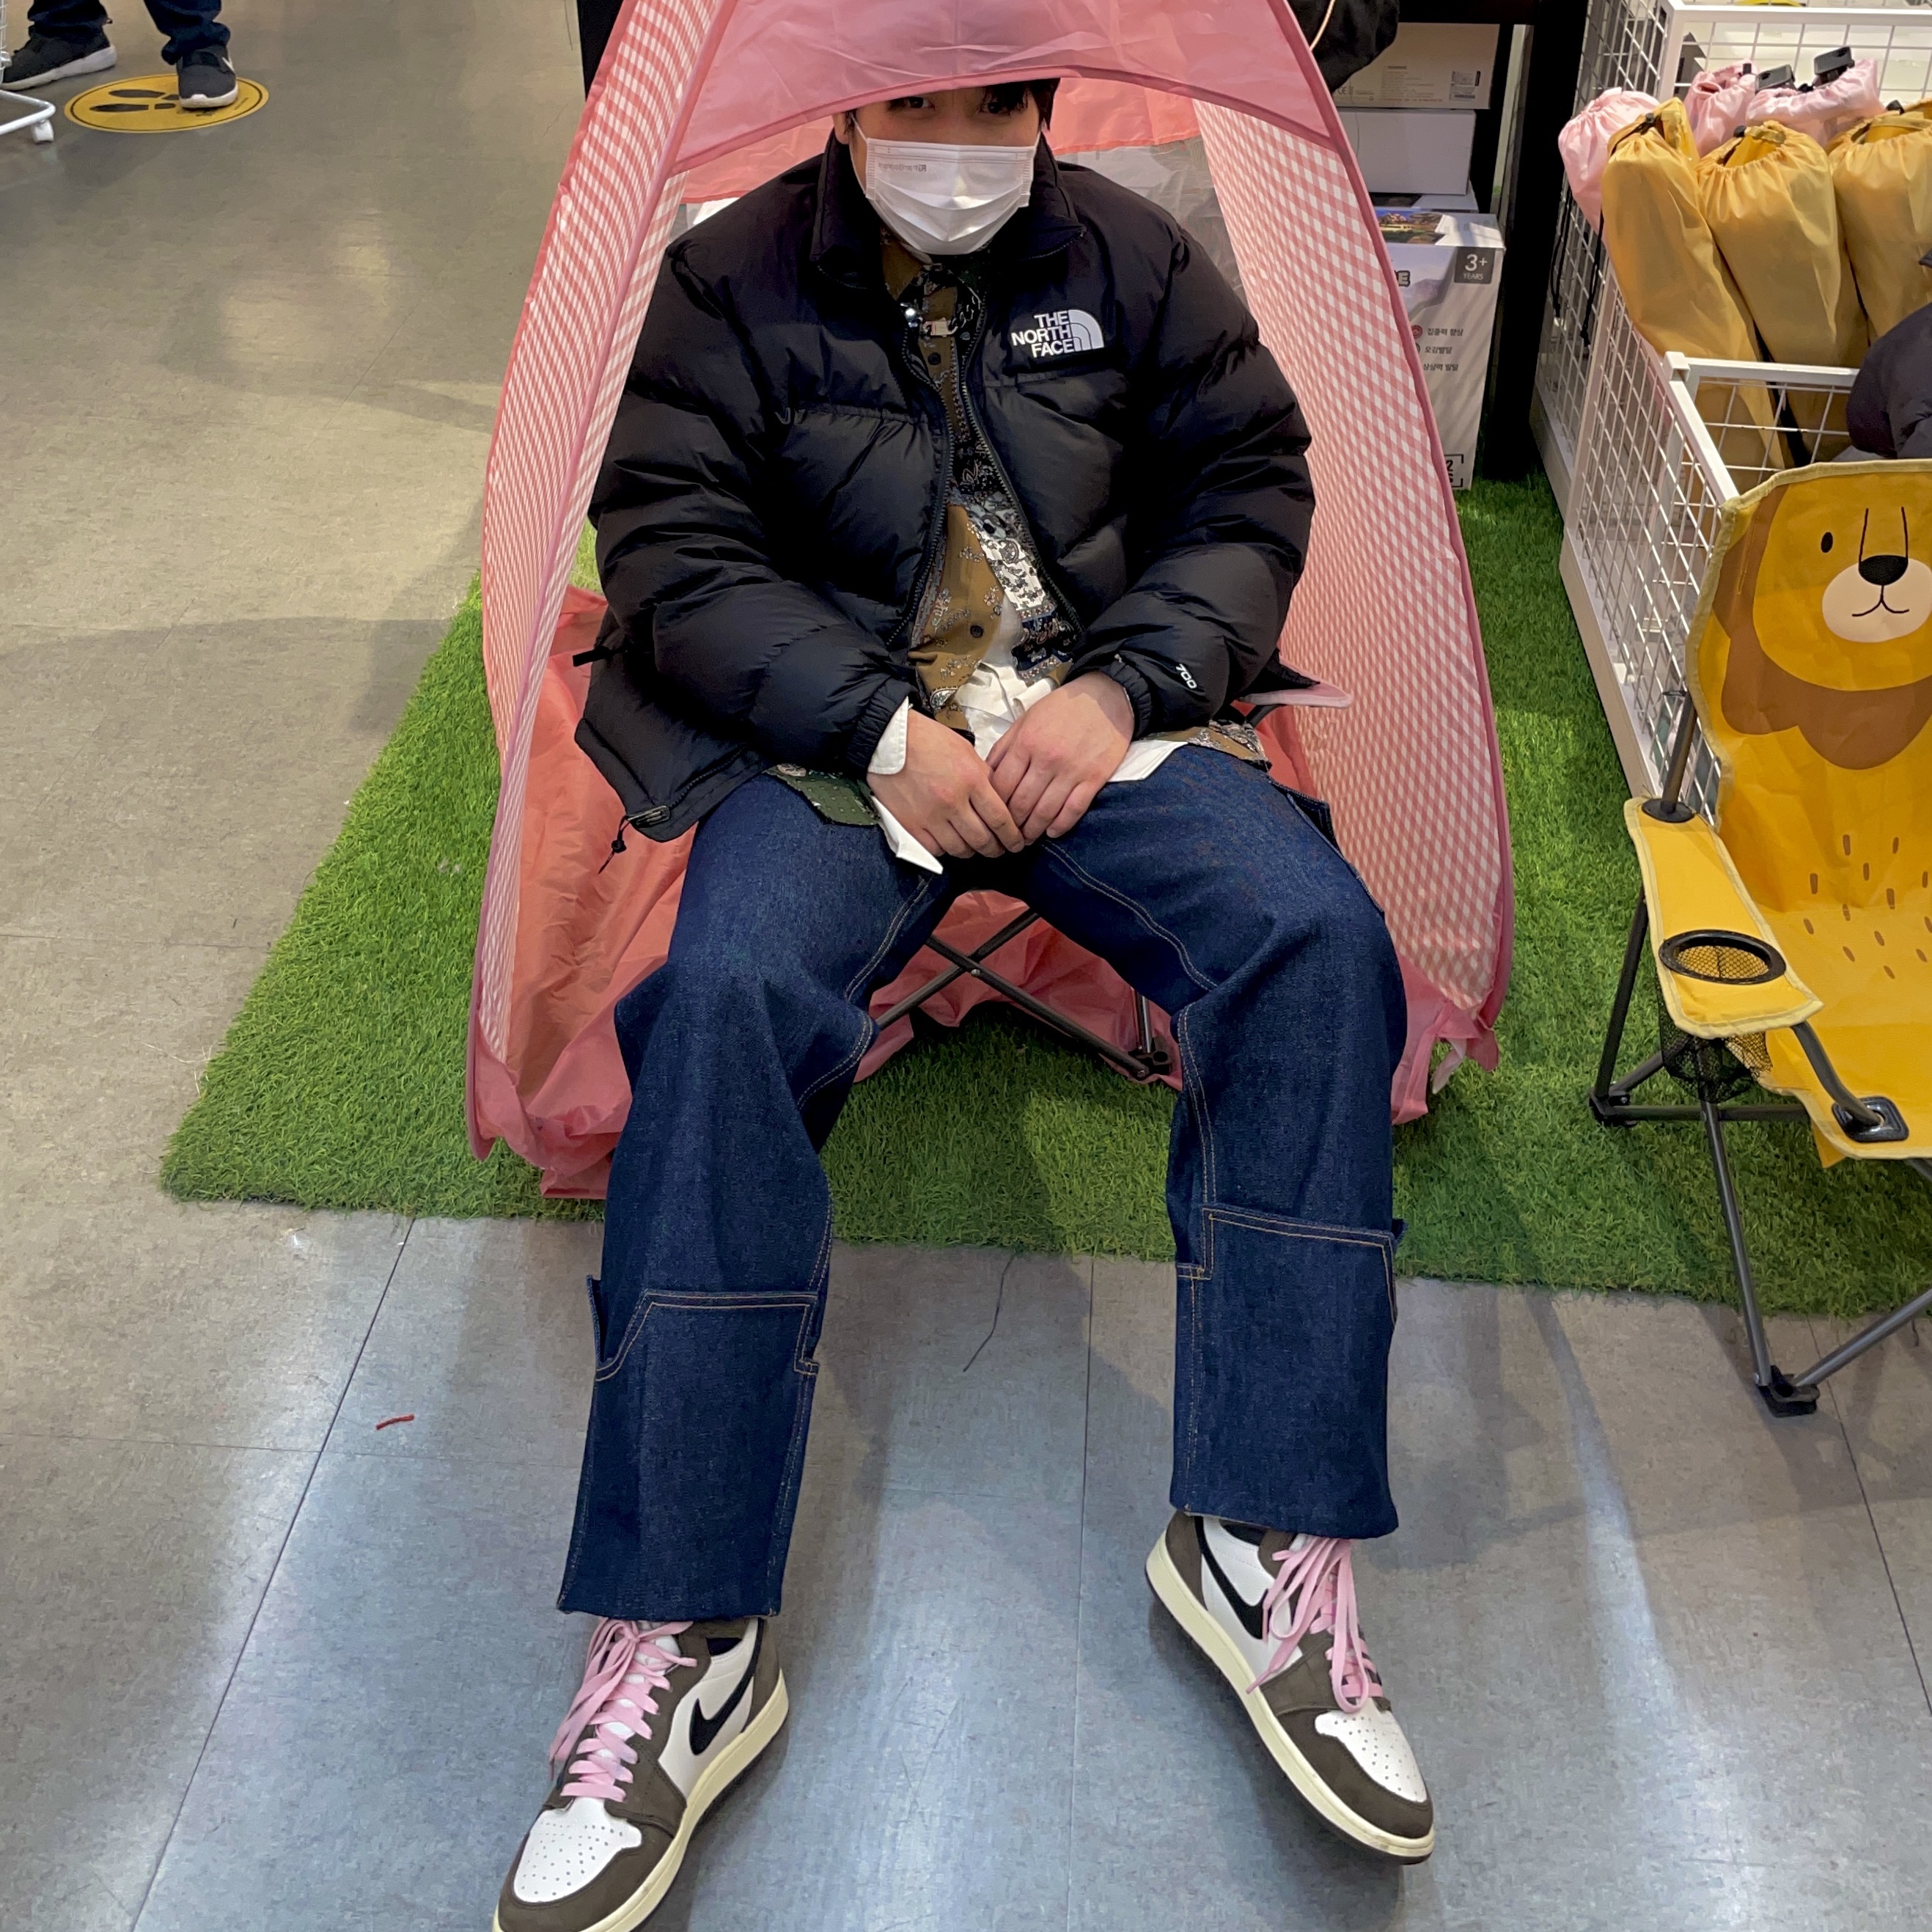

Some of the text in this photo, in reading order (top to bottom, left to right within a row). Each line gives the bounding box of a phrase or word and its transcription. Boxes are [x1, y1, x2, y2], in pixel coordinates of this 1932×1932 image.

[1465, 254, 1488, 271] 3+
[1033, 310, 1070, 328] THE
[1011, 324, 1071, 346] NORTH
[1031, 338, 1075, 358] FACE
[1425, 346, 1452, 354] 오감발달
[1175, 663, 1197, 689] 700
